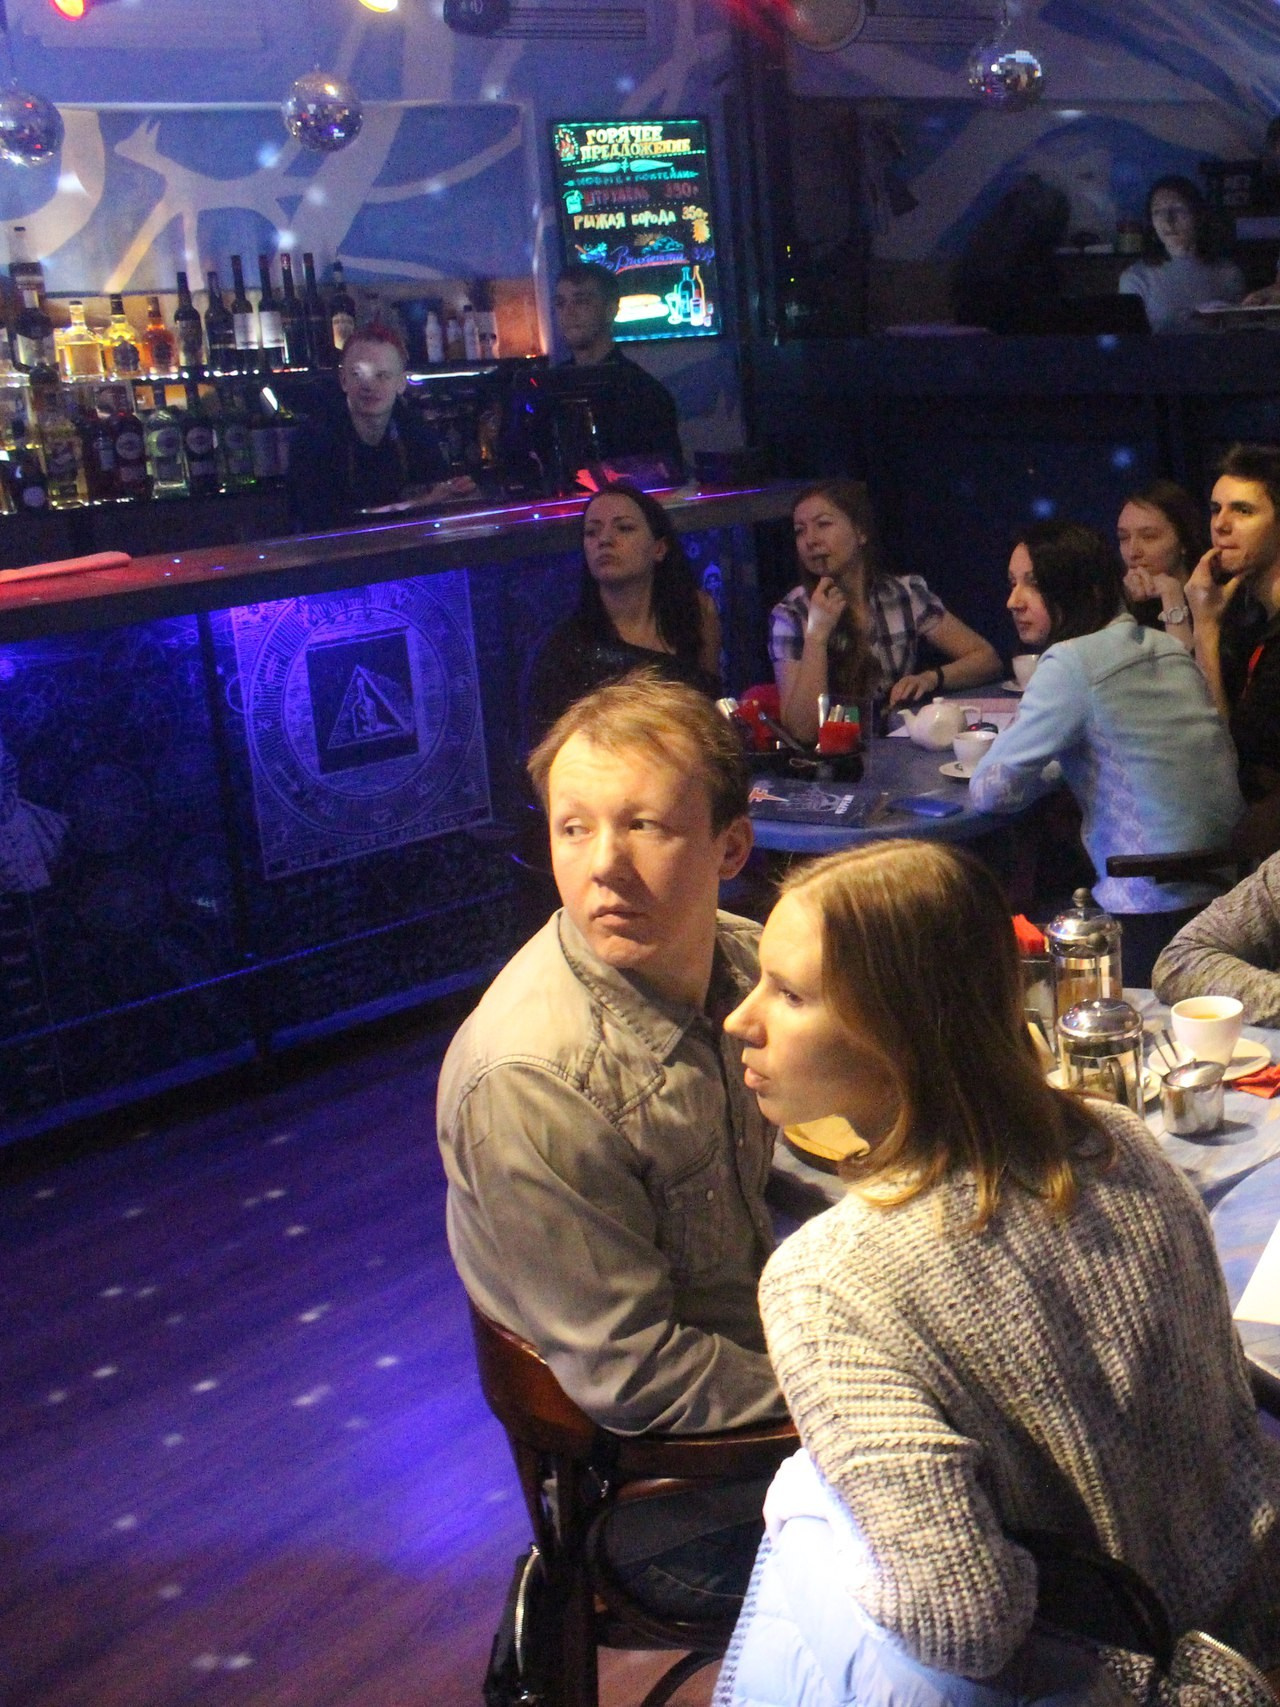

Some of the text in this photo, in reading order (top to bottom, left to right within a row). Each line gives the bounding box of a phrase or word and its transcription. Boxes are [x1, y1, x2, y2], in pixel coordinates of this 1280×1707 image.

[586, 125, 664, 145] ГОРЯЧЕЕ
[580, 138, 692, 160] ПРЕДЛОЖЕНИЕ
[573, 212, 626, 230] РЫЖАЯ
[631, 209, 677, 227] БОРОДА
